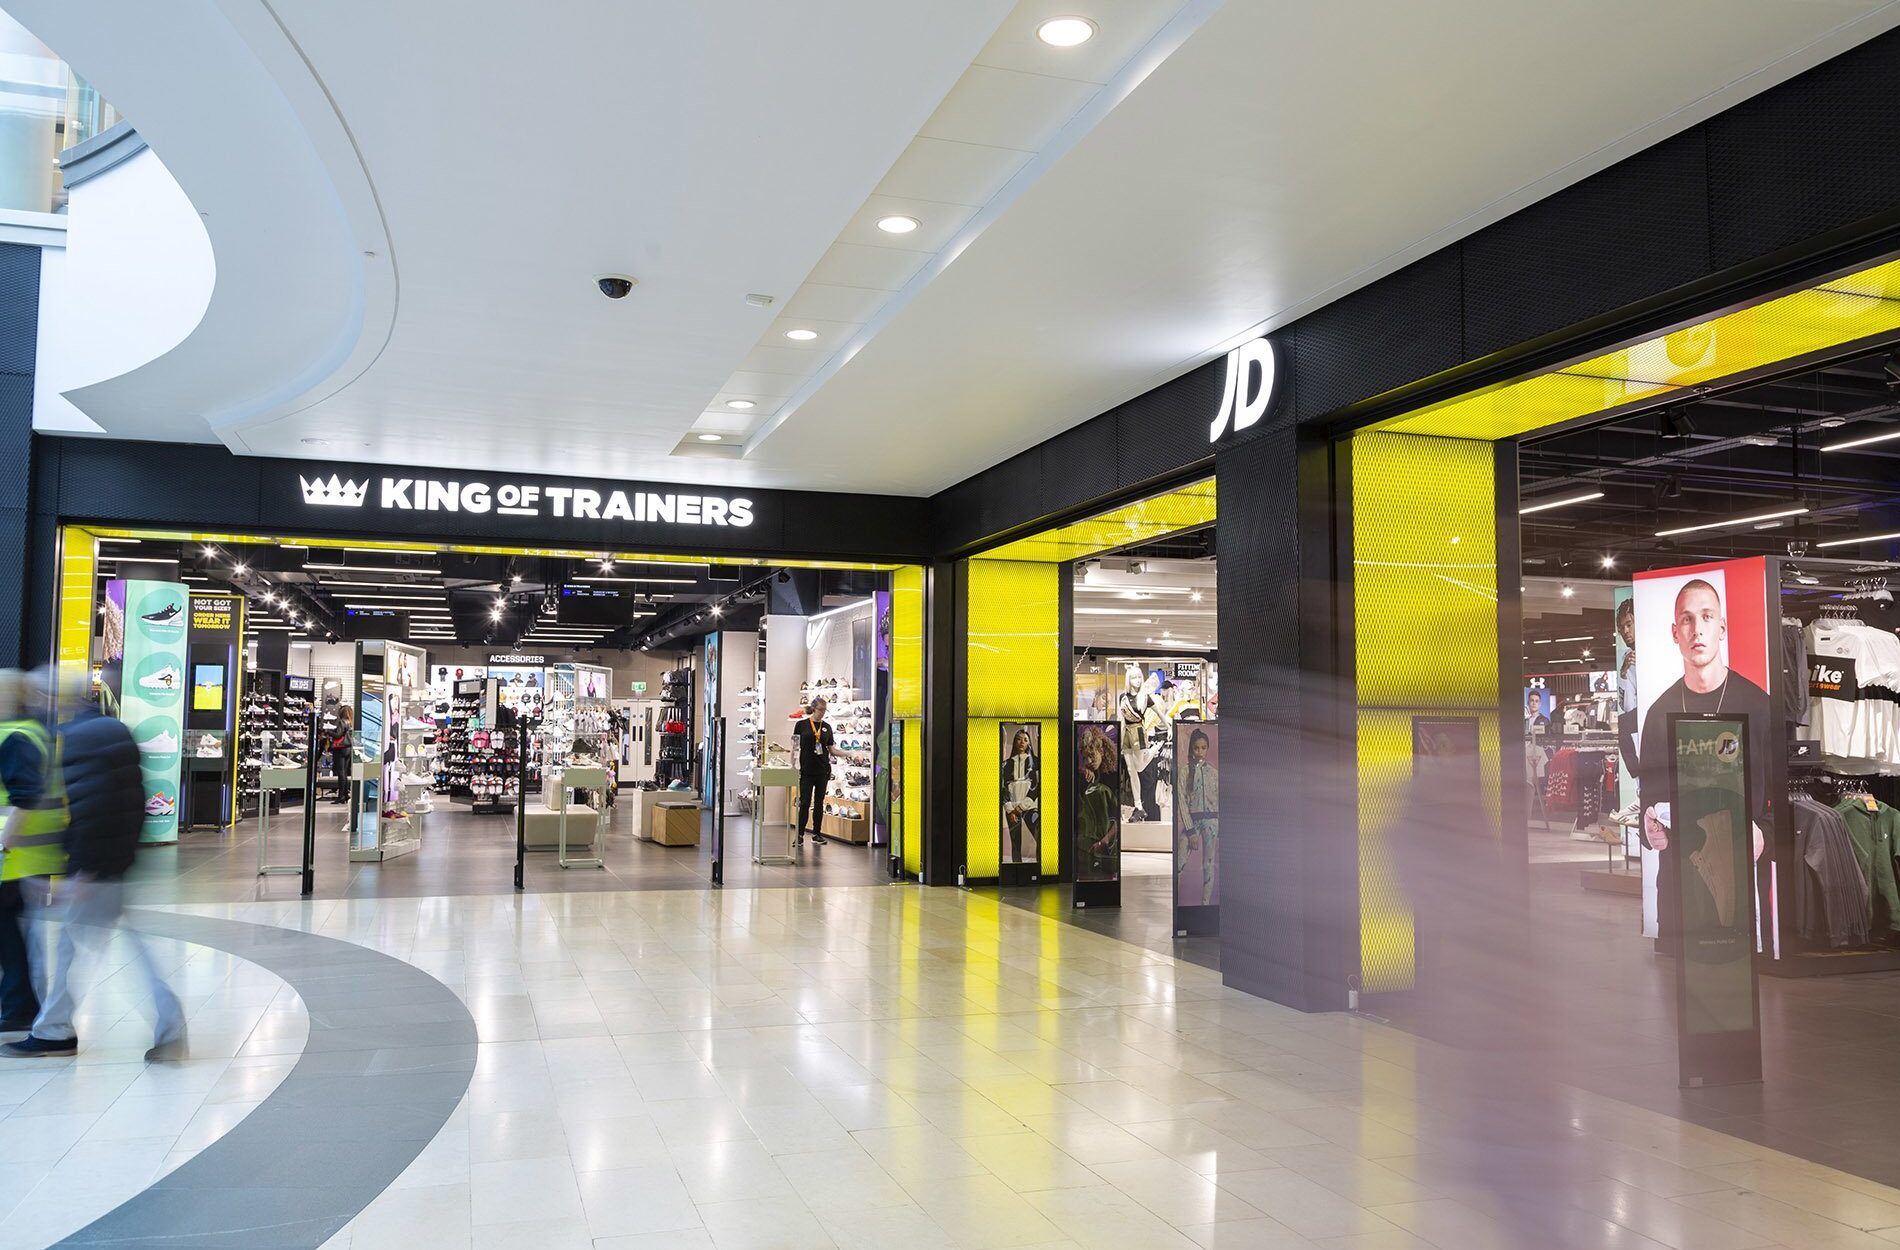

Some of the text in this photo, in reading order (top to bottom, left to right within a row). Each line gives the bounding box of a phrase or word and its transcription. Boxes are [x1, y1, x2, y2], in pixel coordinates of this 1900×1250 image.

[1209, 337, 1275, 443] JD
[381, 477, 755, 527] KING OF TRAINERS
[490, 655, 544, 663] ACCESSORIES
[1717, 738, 1739, 755] JD
